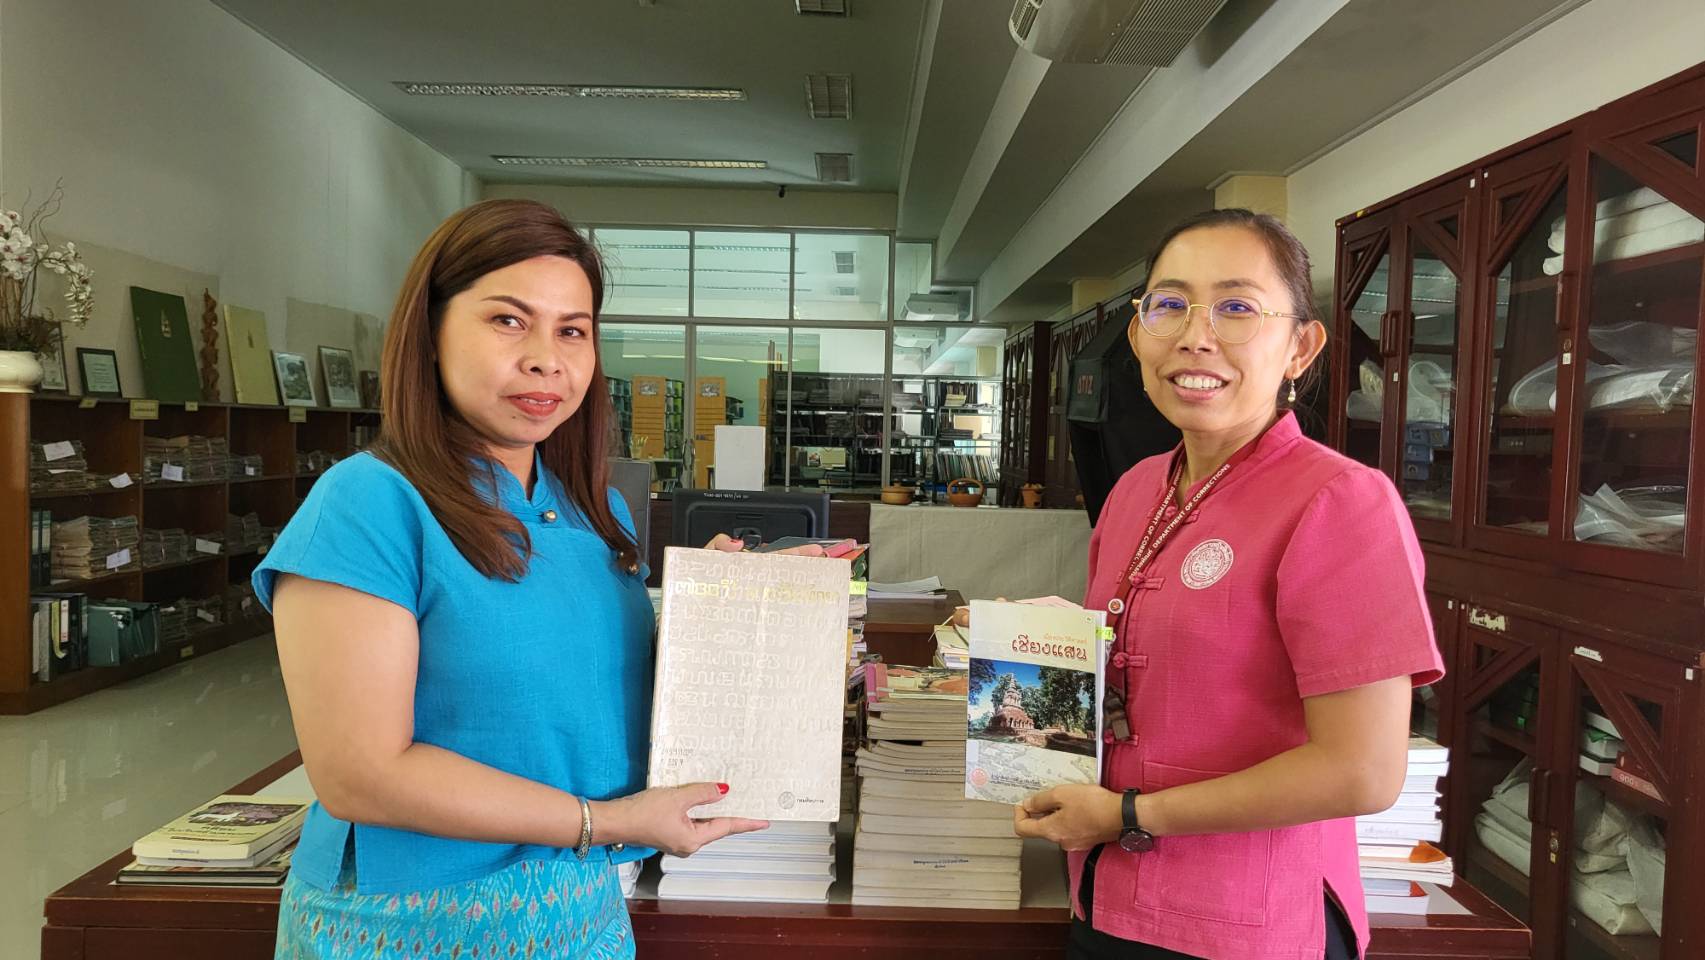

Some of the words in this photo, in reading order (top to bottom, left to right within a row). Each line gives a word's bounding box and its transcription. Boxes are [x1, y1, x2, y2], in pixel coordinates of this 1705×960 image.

[1152, 510, 1186, 549] DEPARTMENT
[1185, 502, 1194, 511] OF
[1193, 463, 1231, 503] CORRECTIONS
[1153, 486, 1176, 526] DEPARTMENT
[1147, 525, 1155, 536] OF
[1012, 634, 1088, 661] เชียงแสน
